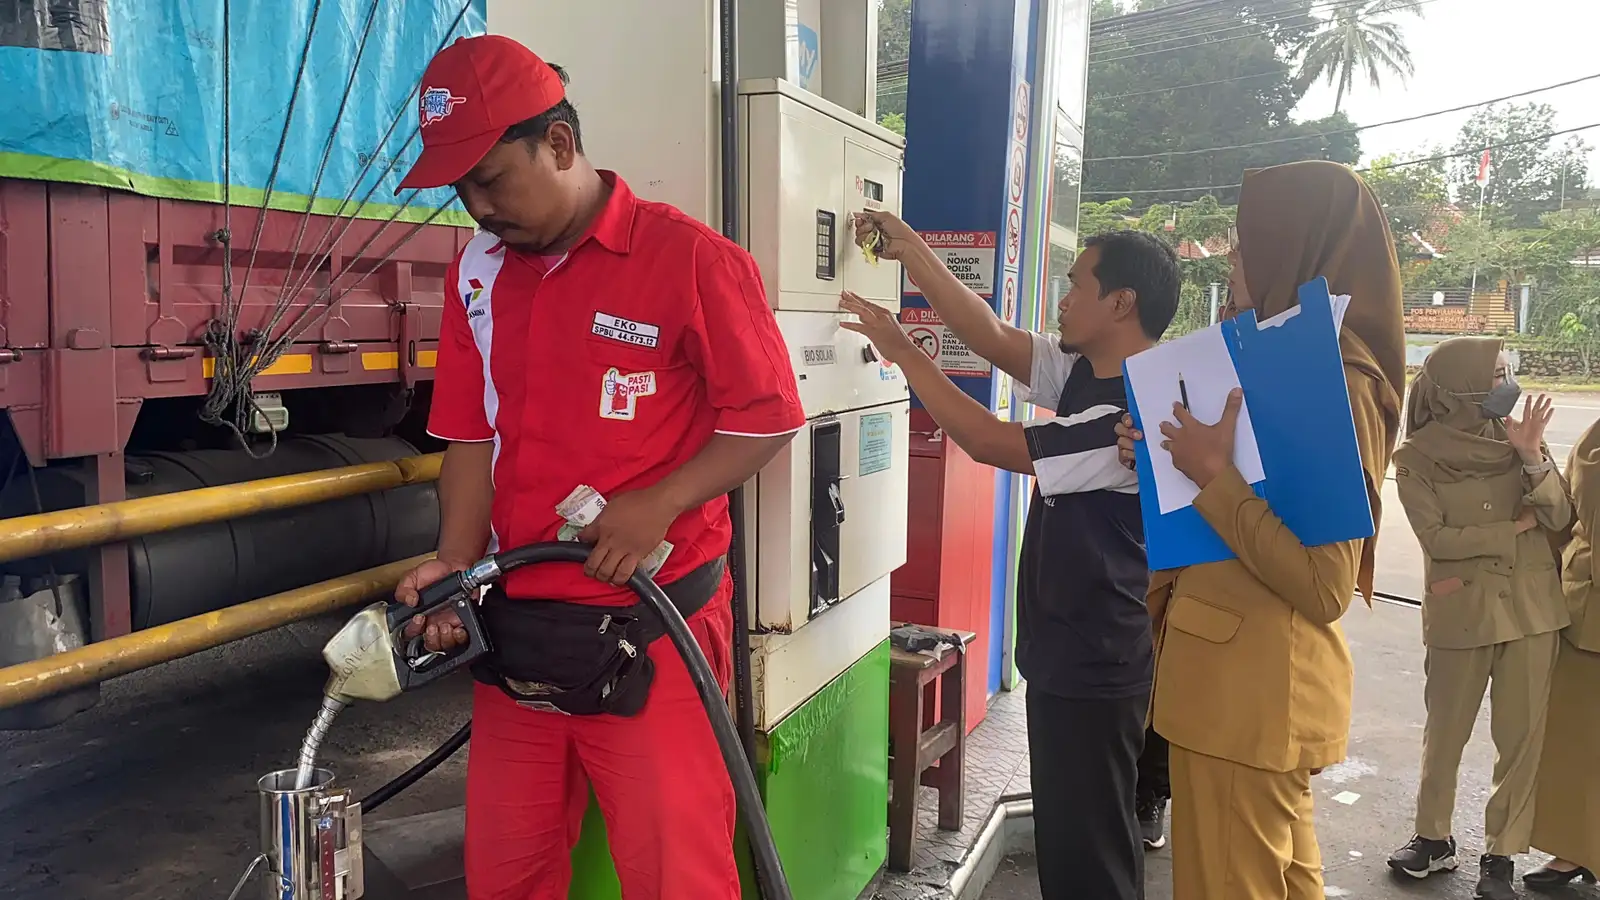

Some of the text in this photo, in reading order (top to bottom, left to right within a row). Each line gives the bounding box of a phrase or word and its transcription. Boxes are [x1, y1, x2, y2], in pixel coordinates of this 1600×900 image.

[855, 175, 864, 195] Rp
[925, 233, 975, 242] DILARANG
[947, 257, 980, 265] NOMOR
[614, 319, 637, 331] EKO
[594, 326, 654, 346] SPBU 44.573.12
[804, 349, 835, 362] BIO SOLAR
[627, 374, 651, 386] PASTI
